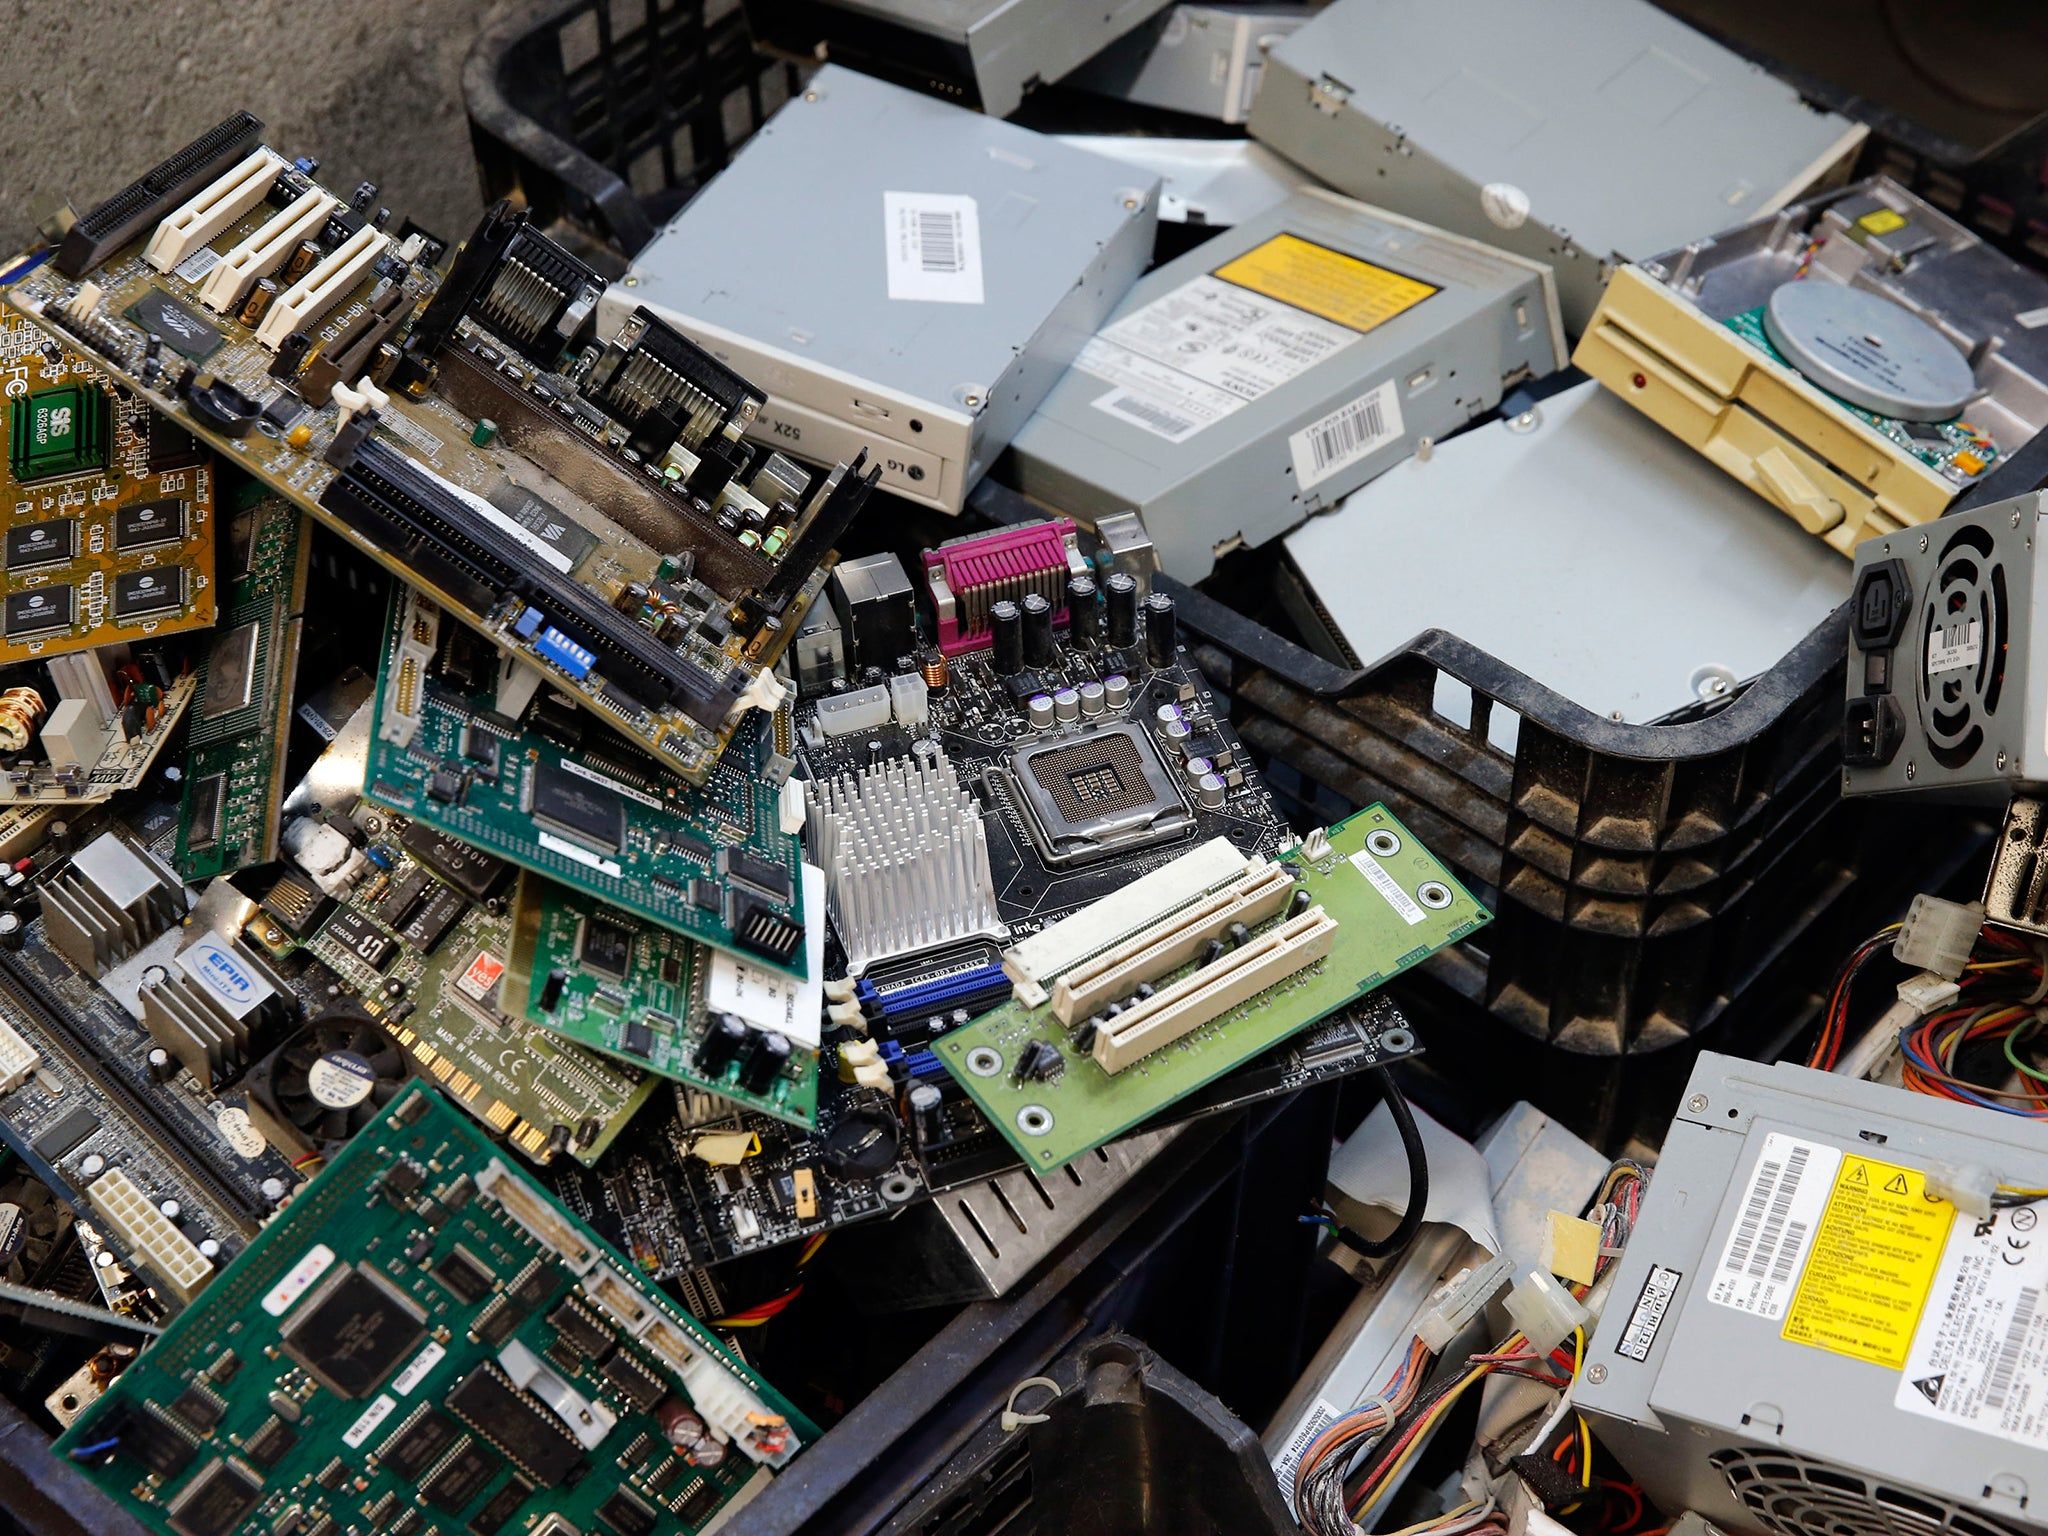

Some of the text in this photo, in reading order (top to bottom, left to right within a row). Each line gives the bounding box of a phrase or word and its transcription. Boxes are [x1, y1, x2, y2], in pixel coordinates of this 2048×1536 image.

[36, 407, 48, 444] 6326AGP
[771, 419, 802, 440] 52X
[885, 458, 905, 472] LG
[432, 842, 465, 871] GTS
[343, 911, 363, 928] 9717
[329, 921, 357, 945] FB2022
[204, 951, 253, 993] EPIA
[468, 964, 496, 988] yes
[875, 980, 906, 993] CANADA
[910, 967, 950, 983] ICES-003
[953, 959, 978, 971] CLASS
[435, 1025, 457, 1045] MADE
[455, 1040, 466, 1053] IN
[465, 1048, 493, 1074] TAIWAN
[495, 1046, 527, 1076] CE
[1838, 1182, 1869, 1195] WARNING
[1832, 1200, 1868, 1214] ATTENTION
[1824, 1223, 1856, 1236] ACHTUNG
[1999, 1231, 2030, 1270] CE
[1807, 1269, 1837, 1282] CUIDADO
[1936, 1338, 1956, 1371] DELTA
